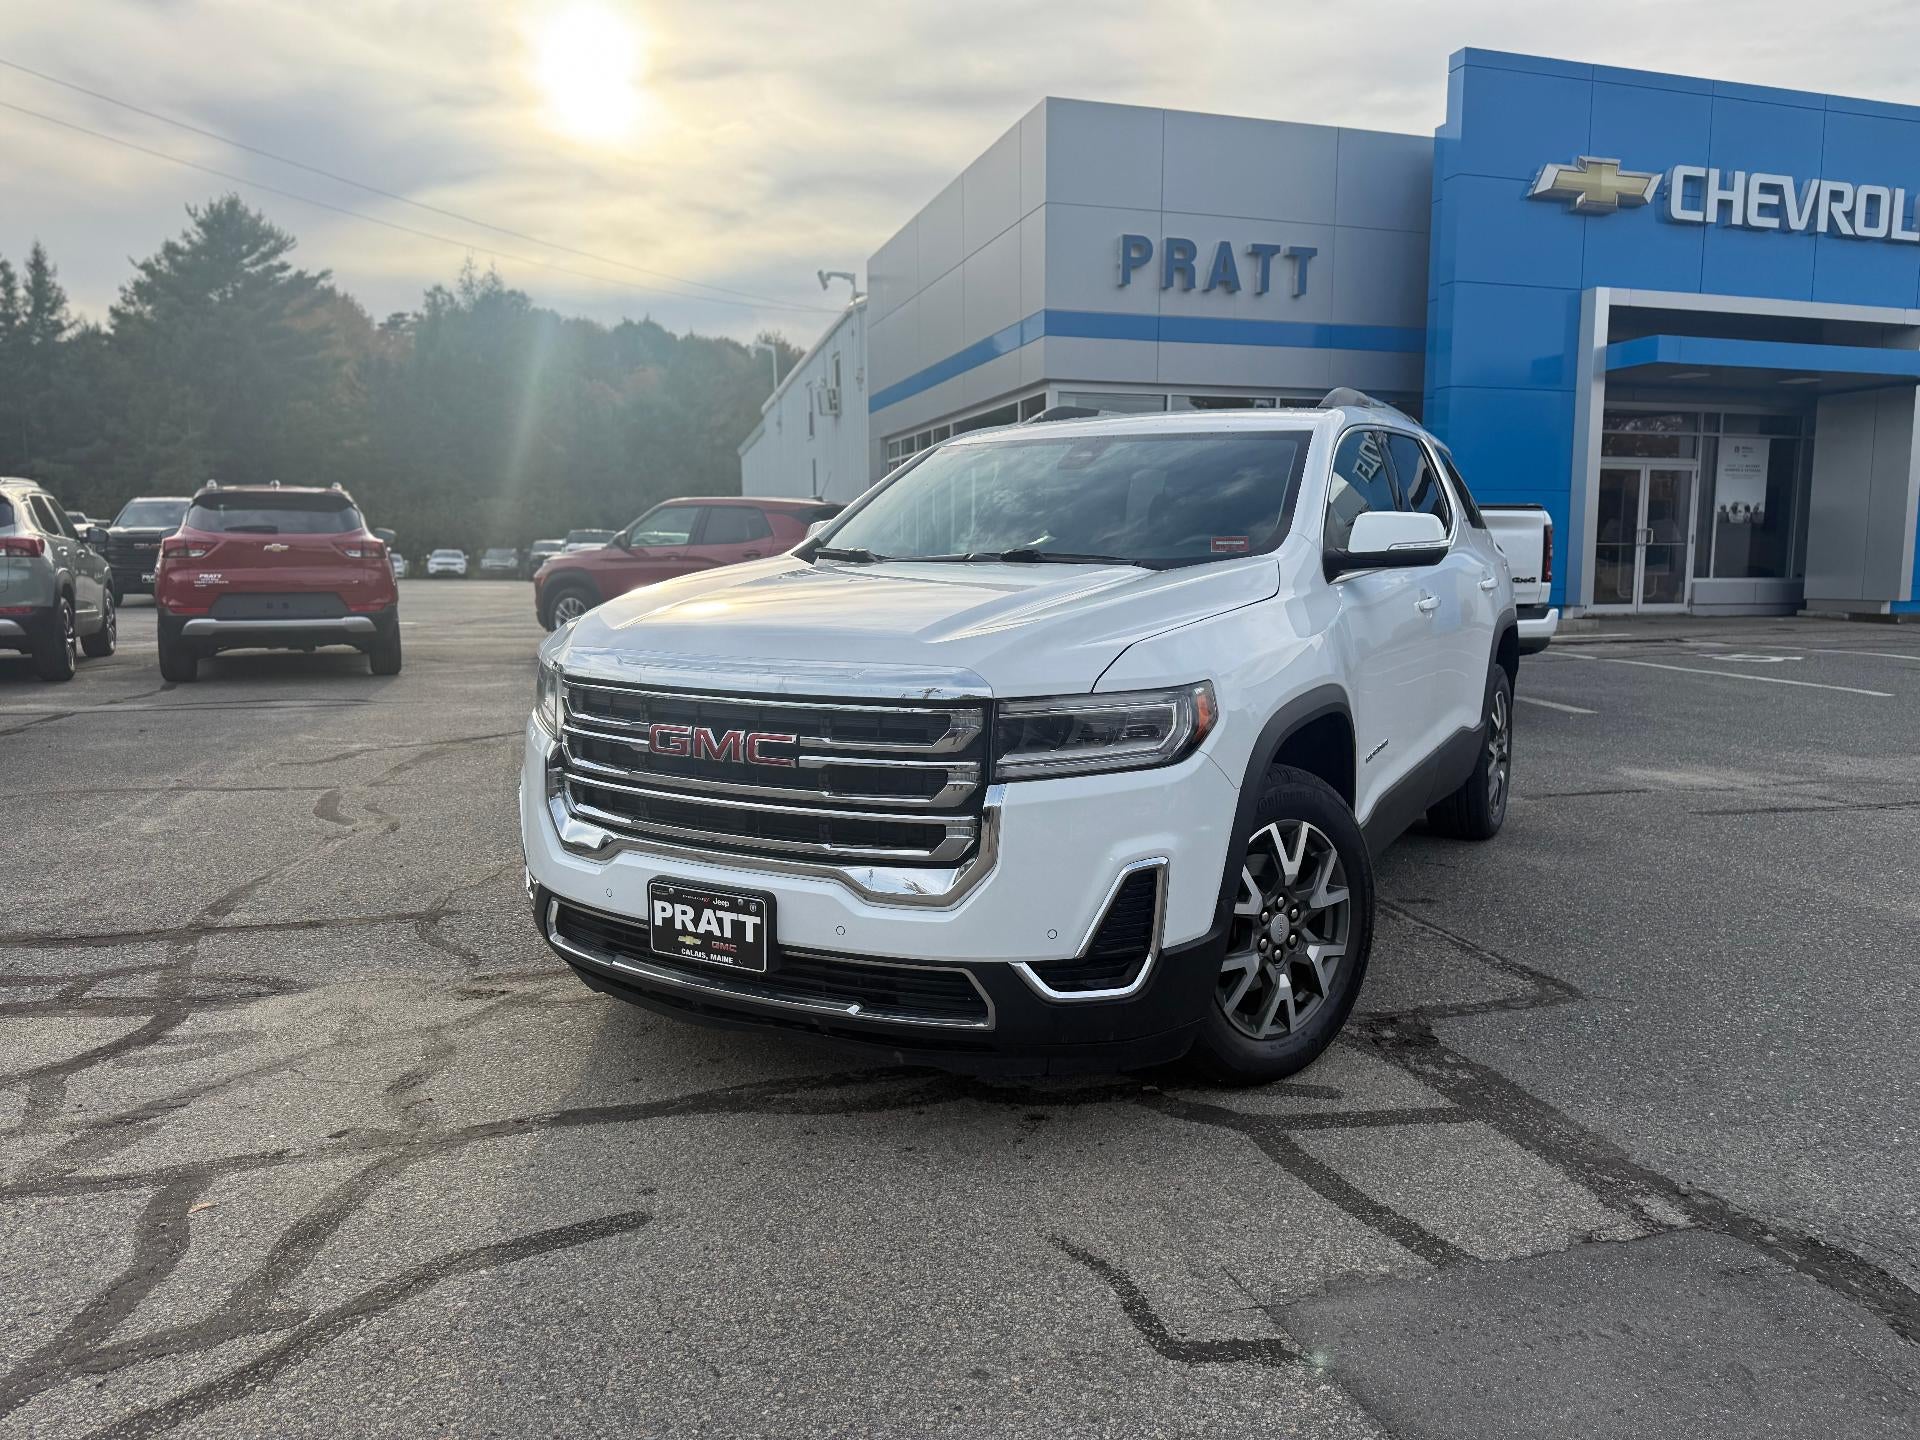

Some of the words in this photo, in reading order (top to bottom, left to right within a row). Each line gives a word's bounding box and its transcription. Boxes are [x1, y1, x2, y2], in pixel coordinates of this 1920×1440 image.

[1671, 165, 1920, 241] CHEVROL
[1119, 234, 1318, 297] PRATT
[650, 723, 797, 768] GMC
[653, 900, 761, 943] PRATT
[712, 897, 730, 908] Jeep
[681, 948, 709, 960] CALAIS,
[710, 953, 734, 964] MAINE
[711, 941, 737, 953] GMC
